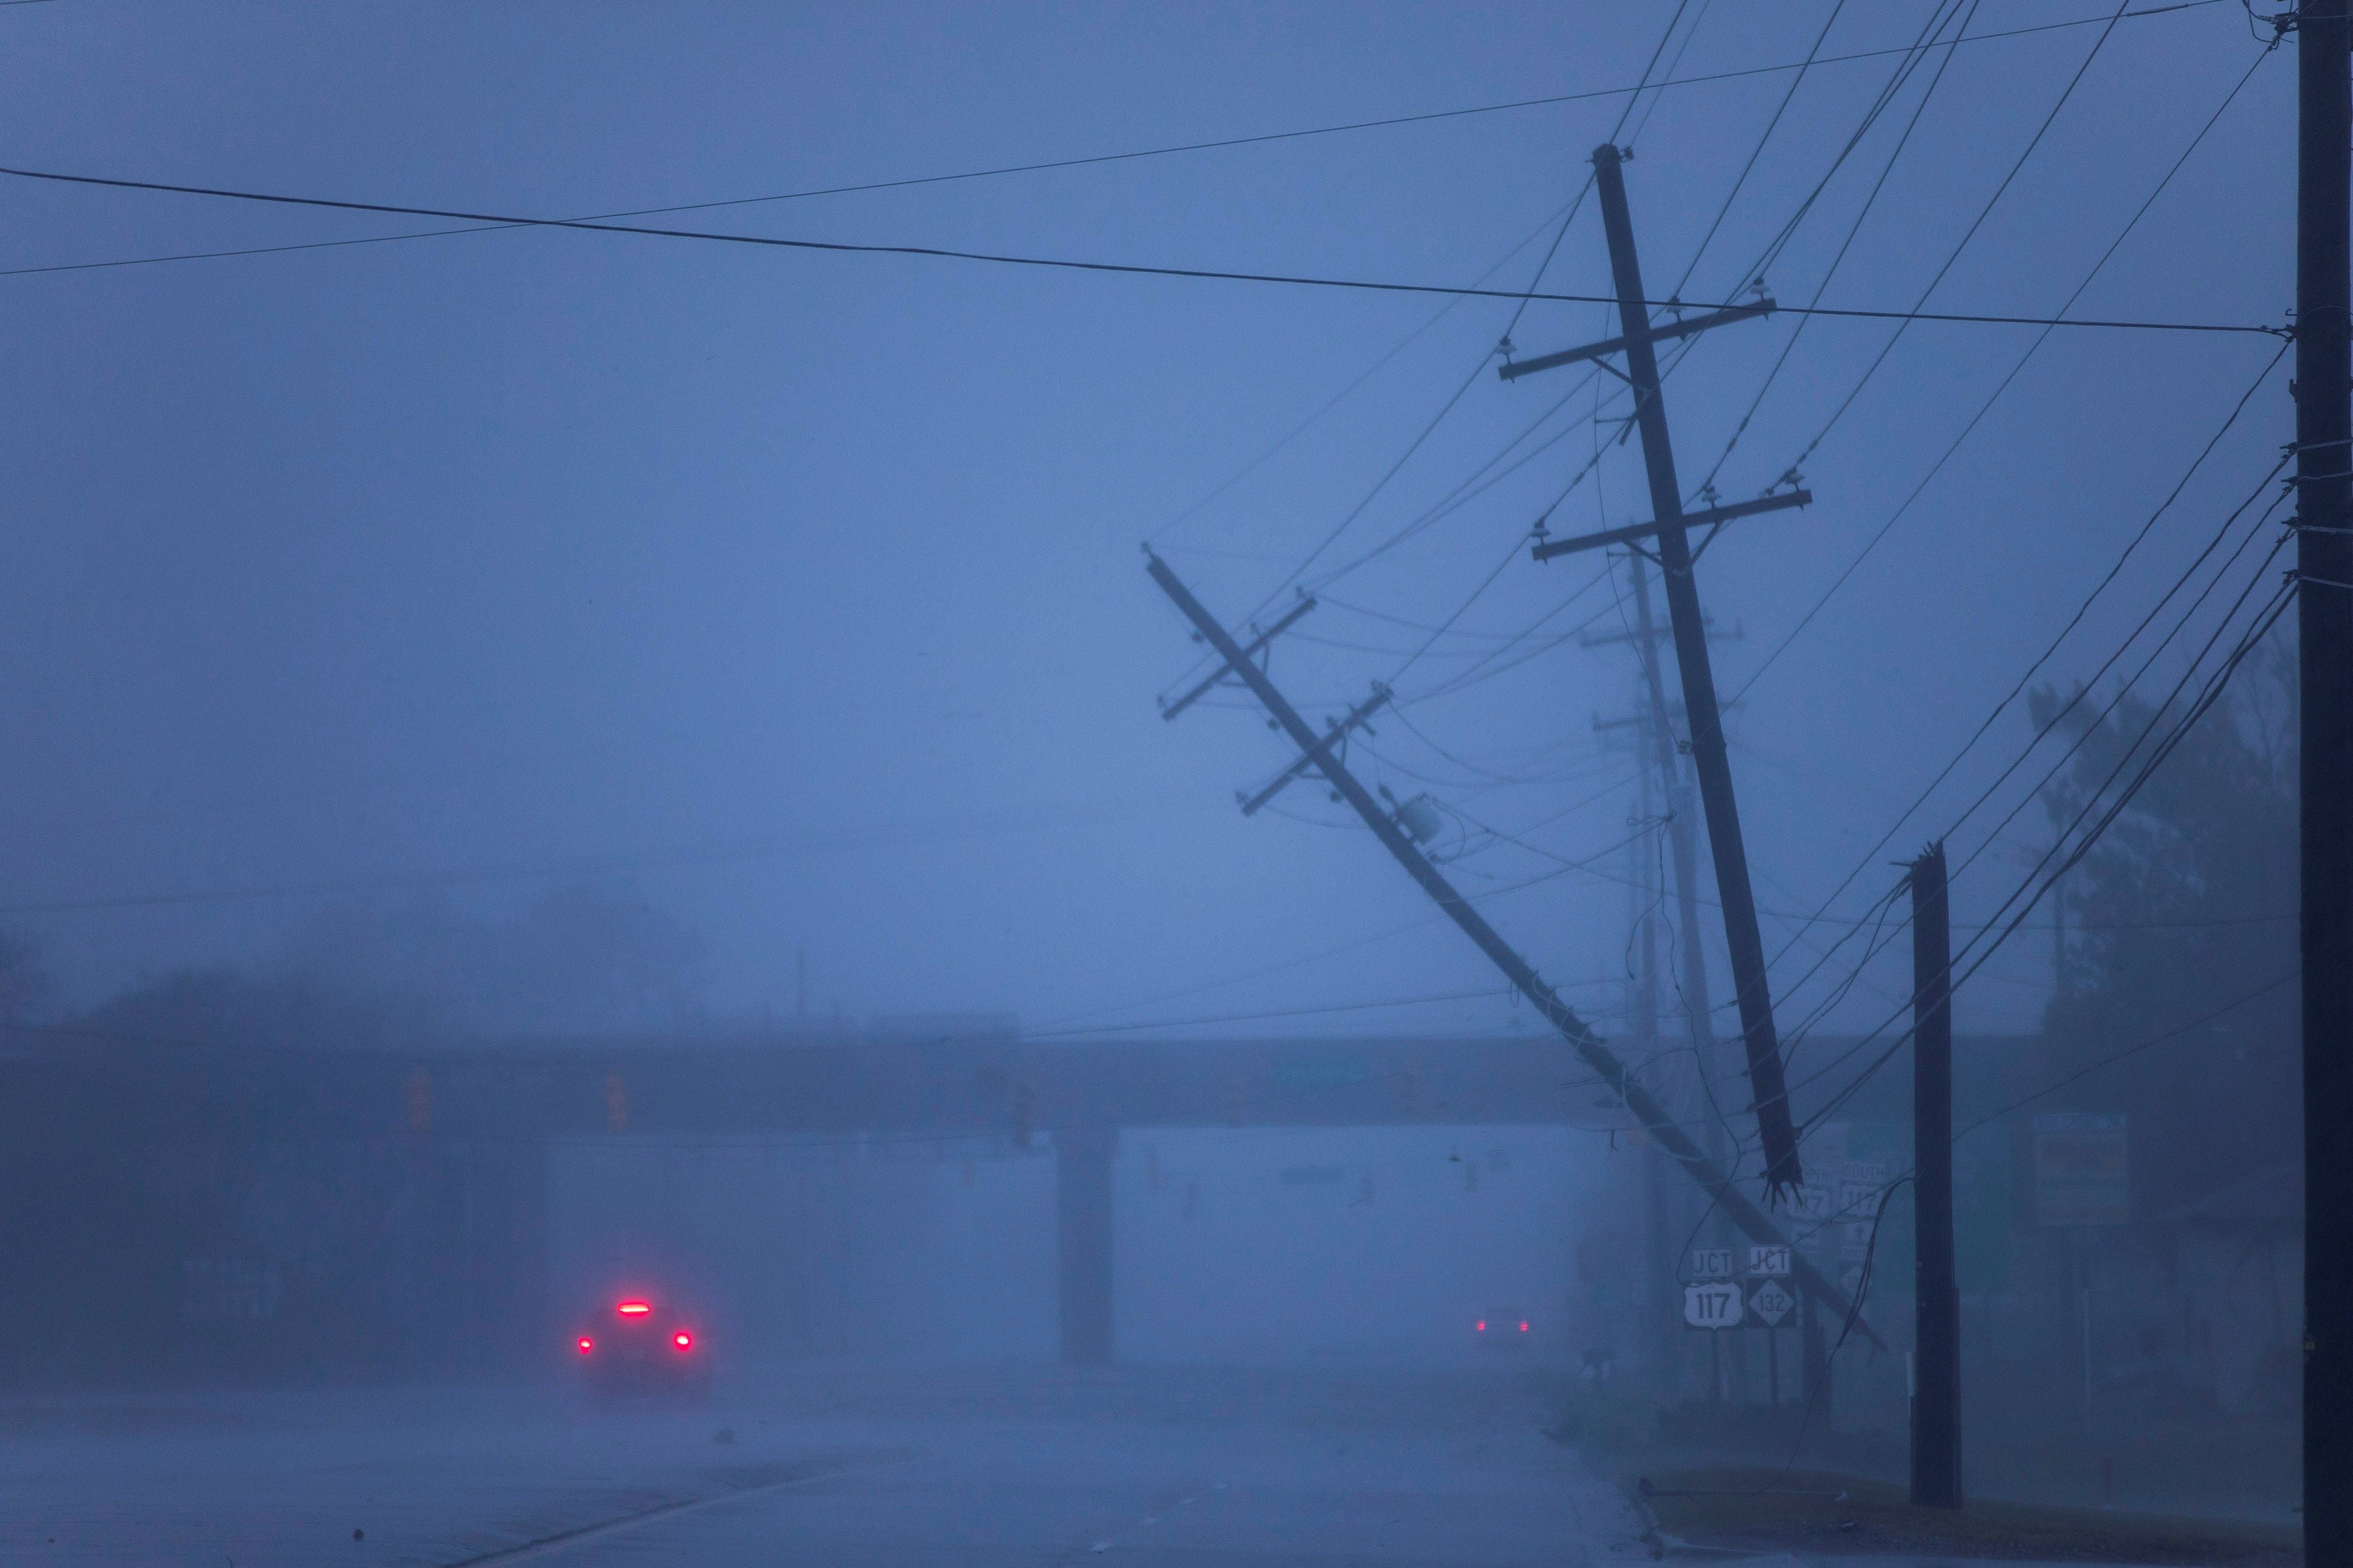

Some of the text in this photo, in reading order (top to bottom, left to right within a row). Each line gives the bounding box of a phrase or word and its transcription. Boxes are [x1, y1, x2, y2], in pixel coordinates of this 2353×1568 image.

[1842, 1164, 1885, 1179] SOUTH
[1848, 1190, 1877, 1211] 117
[1694, 1253, 1730, 1273] JCT
[1751, 1250, 1788, 1270] JCT
[1697, 1293, 1731, 1319] 117
[1759, 1294, 1786, 1312] 132
